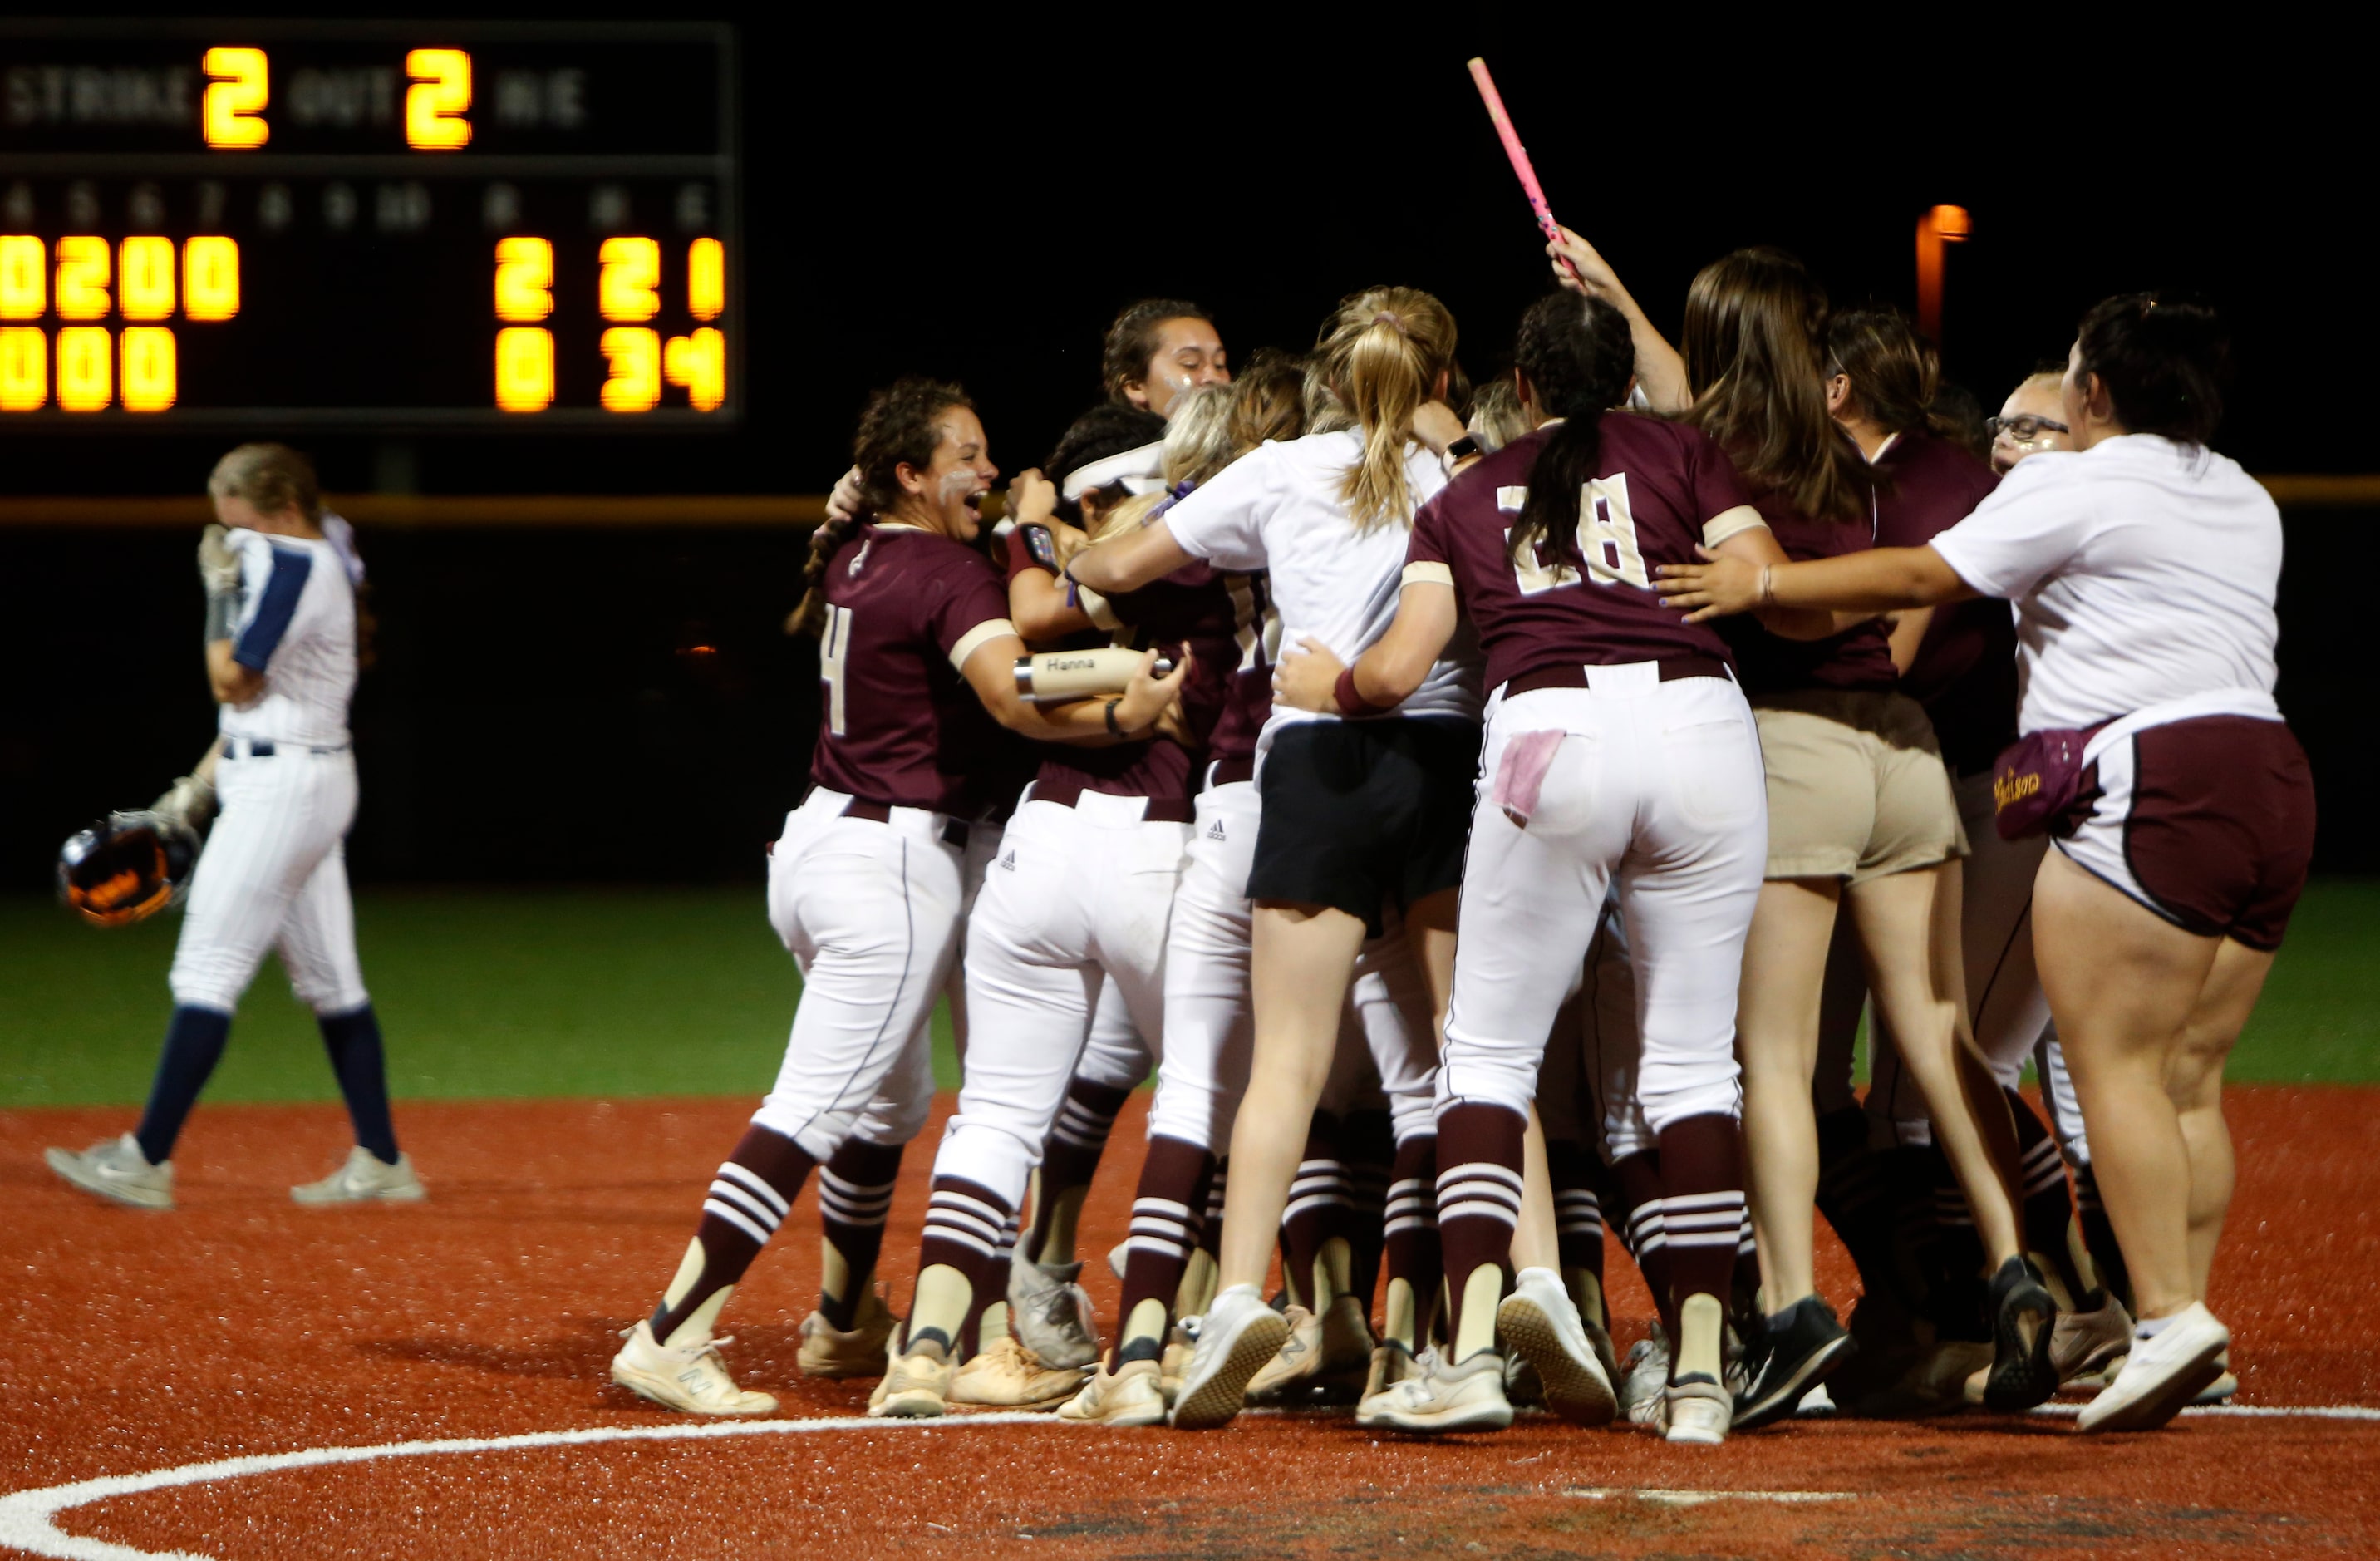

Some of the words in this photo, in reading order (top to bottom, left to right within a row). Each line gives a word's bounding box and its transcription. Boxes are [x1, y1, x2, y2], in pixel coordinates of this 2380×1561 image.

[4, 64, 196, 127] STRIKE
[203, 47, 268, 149] 2
[288, 66, 395, 128] OUT
[406, 48, 472, 150] 2
[0, 235, 47, 320] 0
[55, 236, 111, 320] 2
[118, 236, 176, 321] 0
[182, 236, 239, 321] 0
[494, 237, 554, 322] 2
[599, 237, 661, 323] 2
[688, 238, 725, 321] 1
[0, 327, 47, 411] 0
[56, 327, 112, 412] 0
[120, 327, 177, 412] 0
[495, 327, 555, 412] 0
[600, 327, 661, 412] 3
[664, 327, 725, 412] 4
[820, 603, 853, 735] 4
[1047, 657, 1095, 672] Hanna
